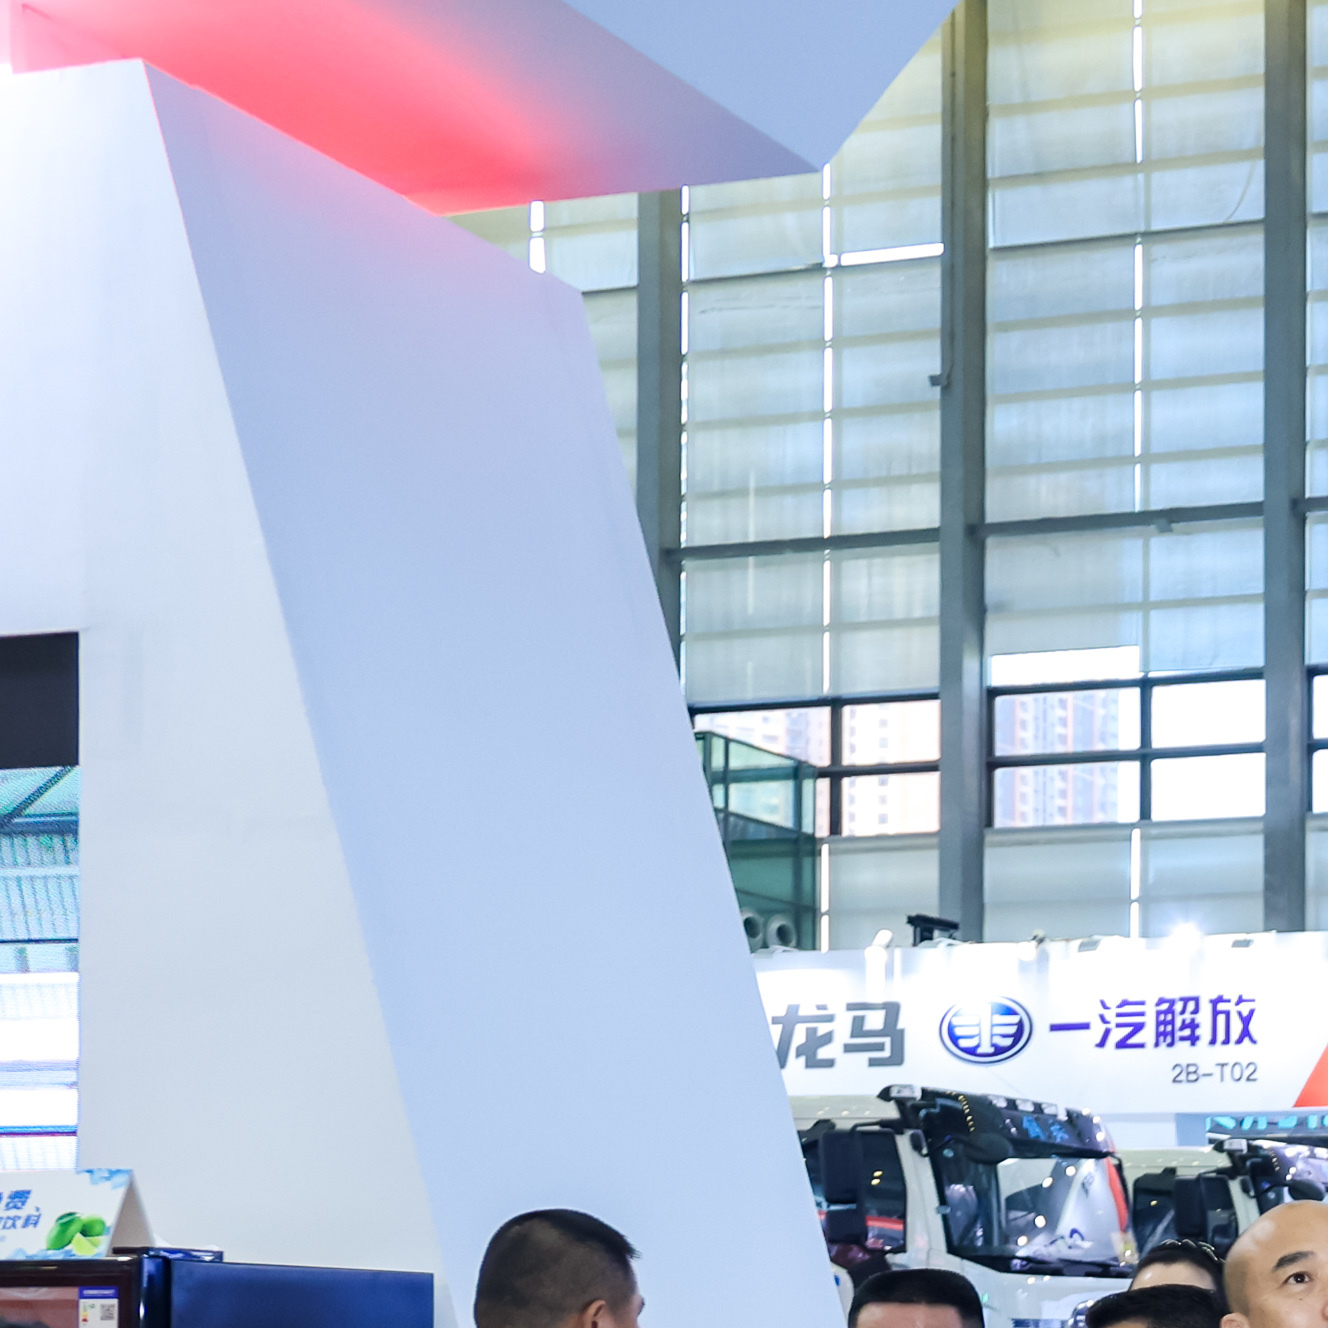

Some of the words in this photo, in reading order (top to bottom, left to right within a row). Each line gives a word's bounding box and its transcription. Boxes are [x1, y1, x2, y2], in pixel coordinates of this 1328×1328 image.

[1049, 994, 1257, 1051] 一汽解放
[1171, 1062, 1258, 1084] 2B-T02
[0, 1190, 32, 1211] 费
